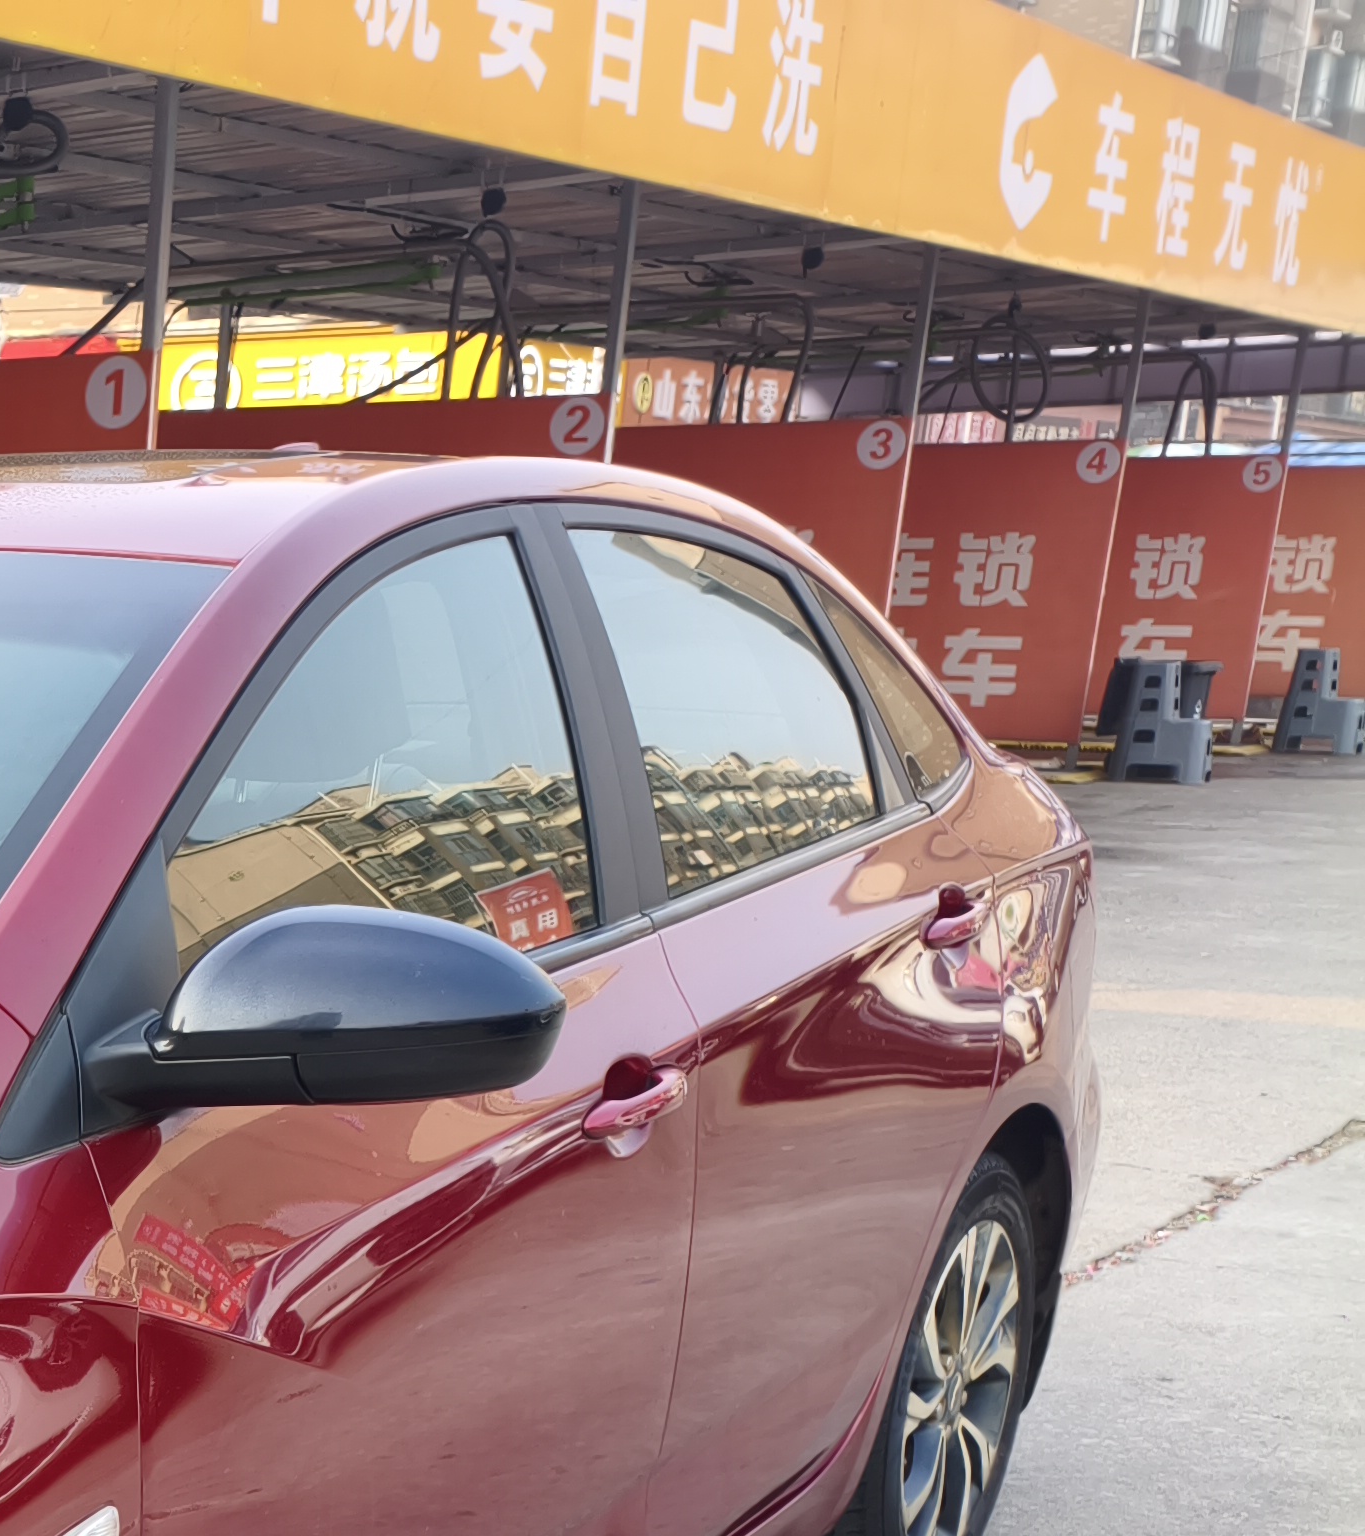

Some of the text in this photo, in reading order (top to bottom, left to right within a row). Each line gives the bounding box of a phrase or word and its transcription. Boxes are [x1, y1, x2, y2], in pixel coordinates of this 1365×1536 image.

[1087, 90, 1309, 289] 车程无忧
[103, 368, 125, 419] 1
[564, 405, 591, 443] 2
[870, 428, 894, 463] 3
[1086, 447, 1109, 476] 4
[1251, 463, 1272, 487] 5
[944, 627, 1023, 708] 车
